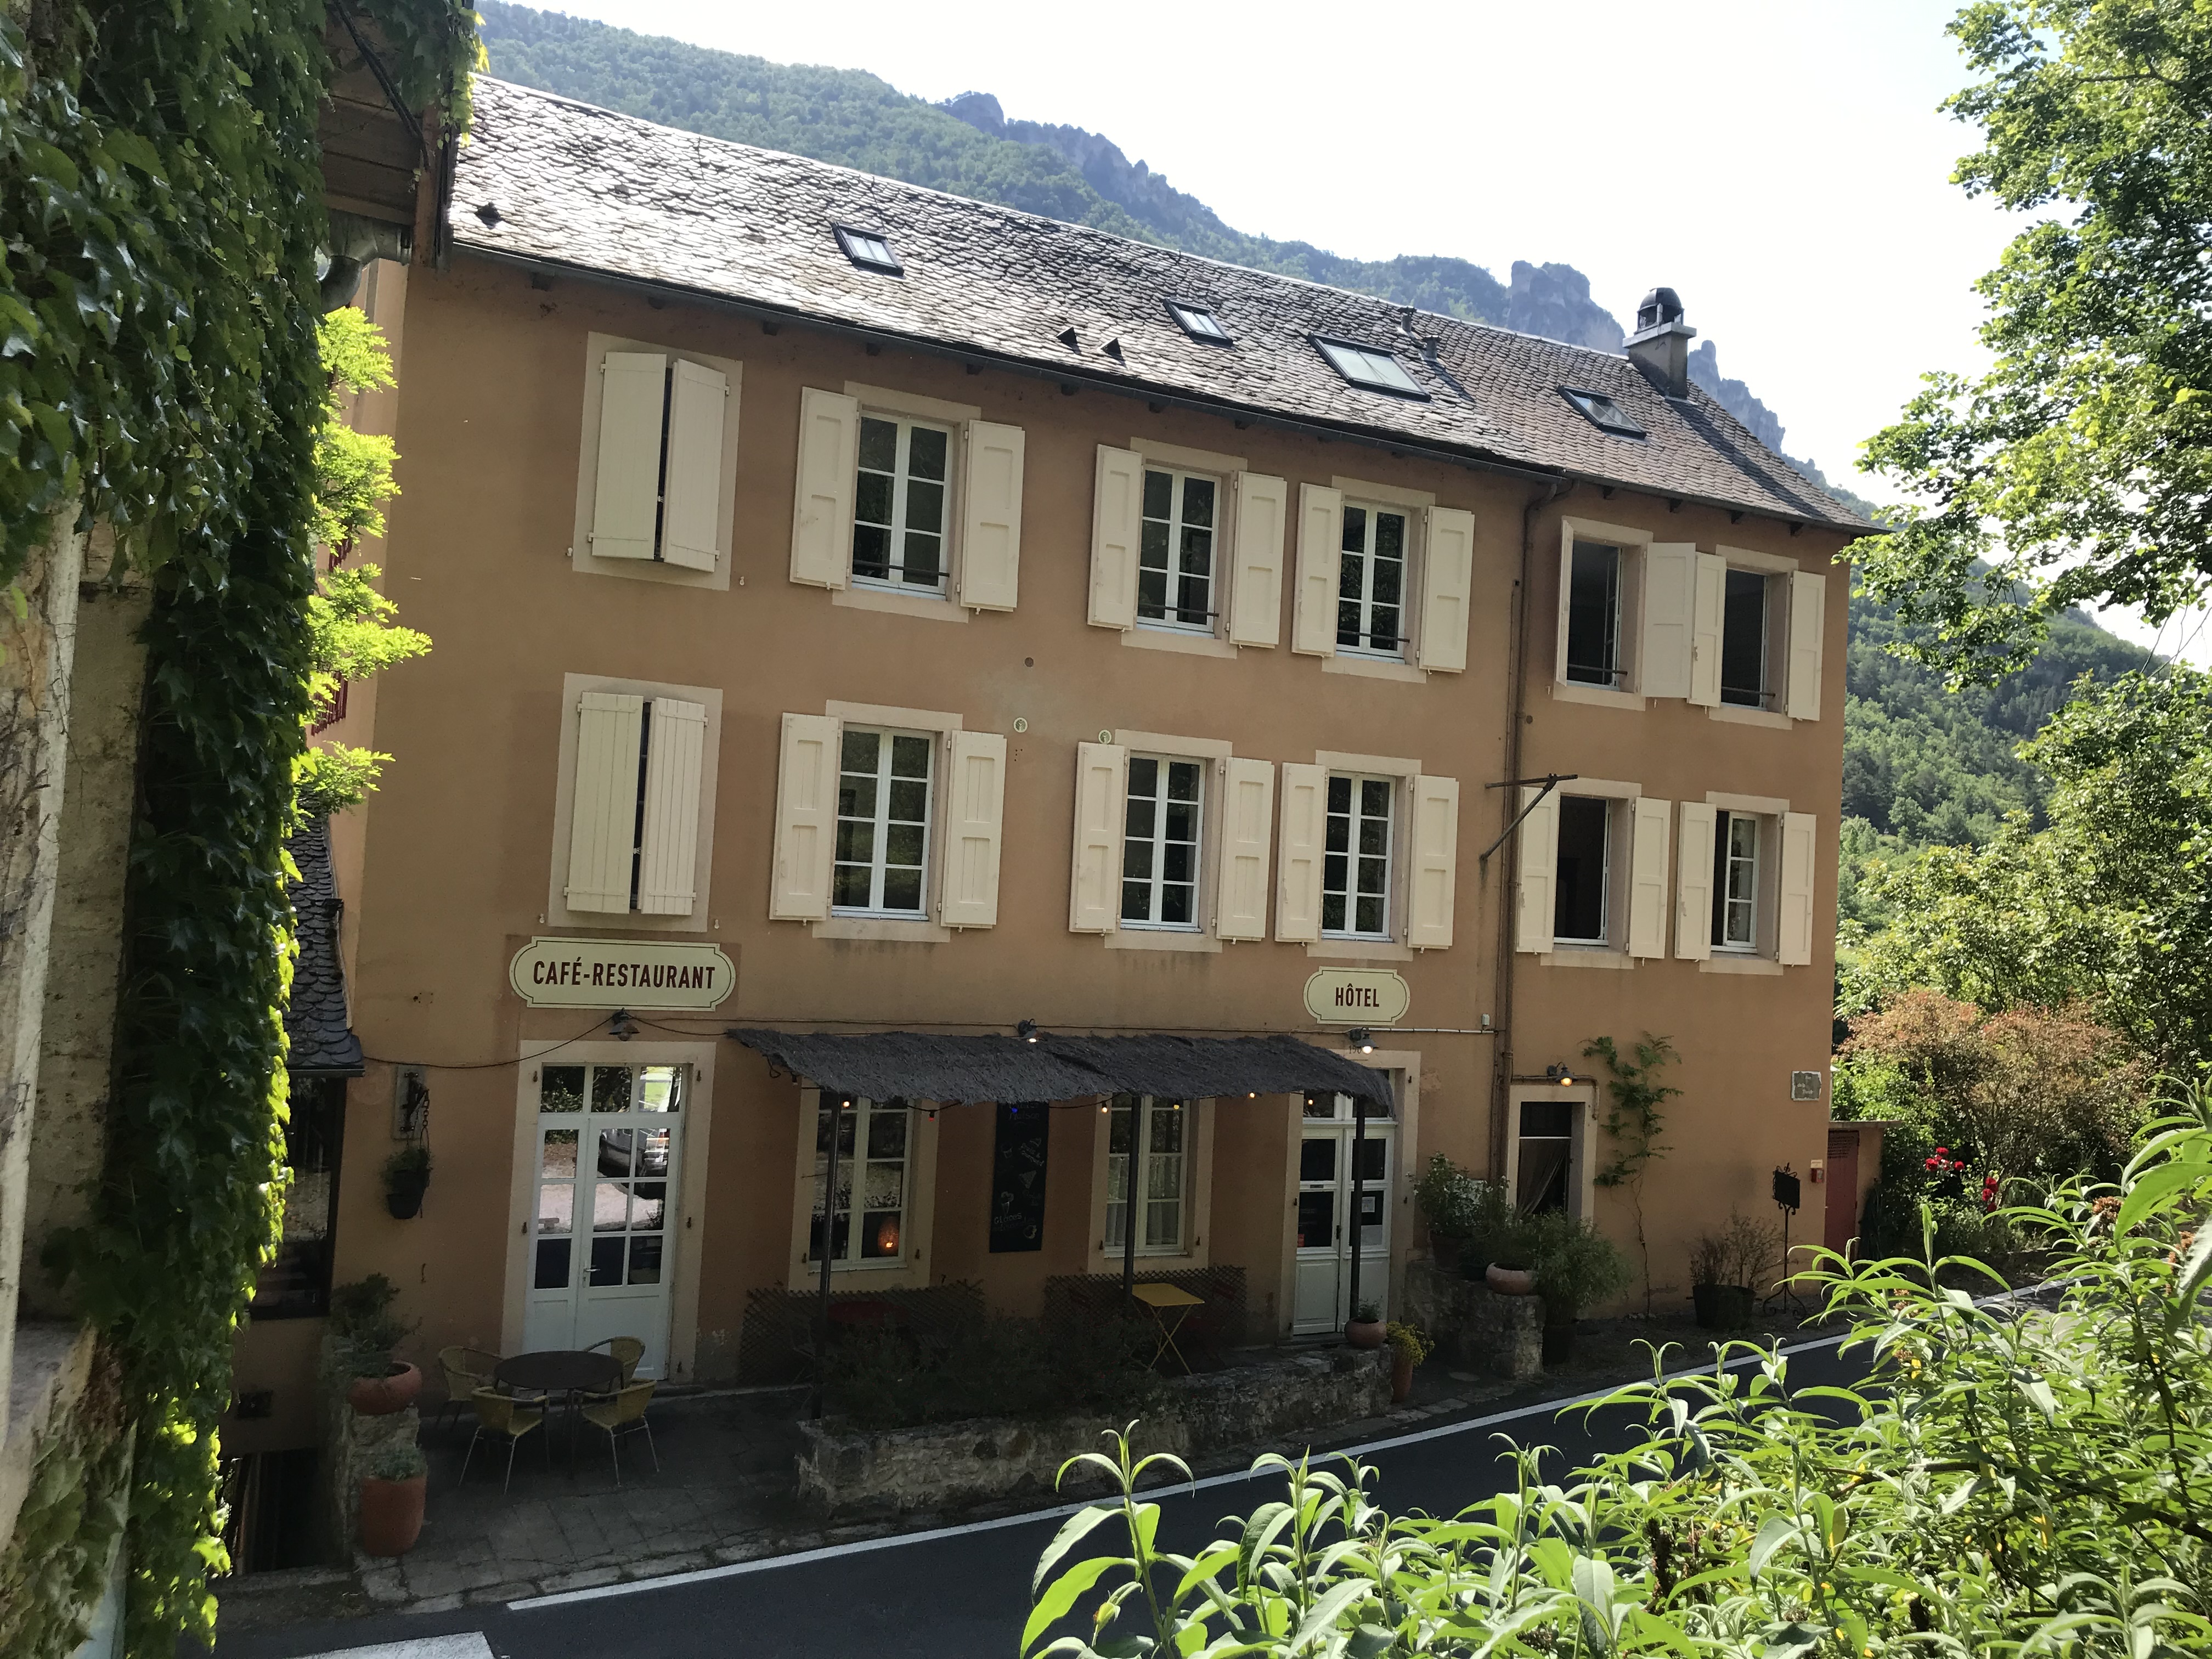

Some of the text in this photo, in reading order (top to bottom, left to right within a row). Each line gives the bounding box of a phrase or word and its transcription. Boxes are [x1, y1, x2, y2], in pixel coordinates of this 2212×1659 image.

[533, 957, 715, 989] CAFÉ-RESTAURANT
[1335, 983, 1380, 1007] HÔTEL
[994, 1212, 1023, 1224] Glaces
